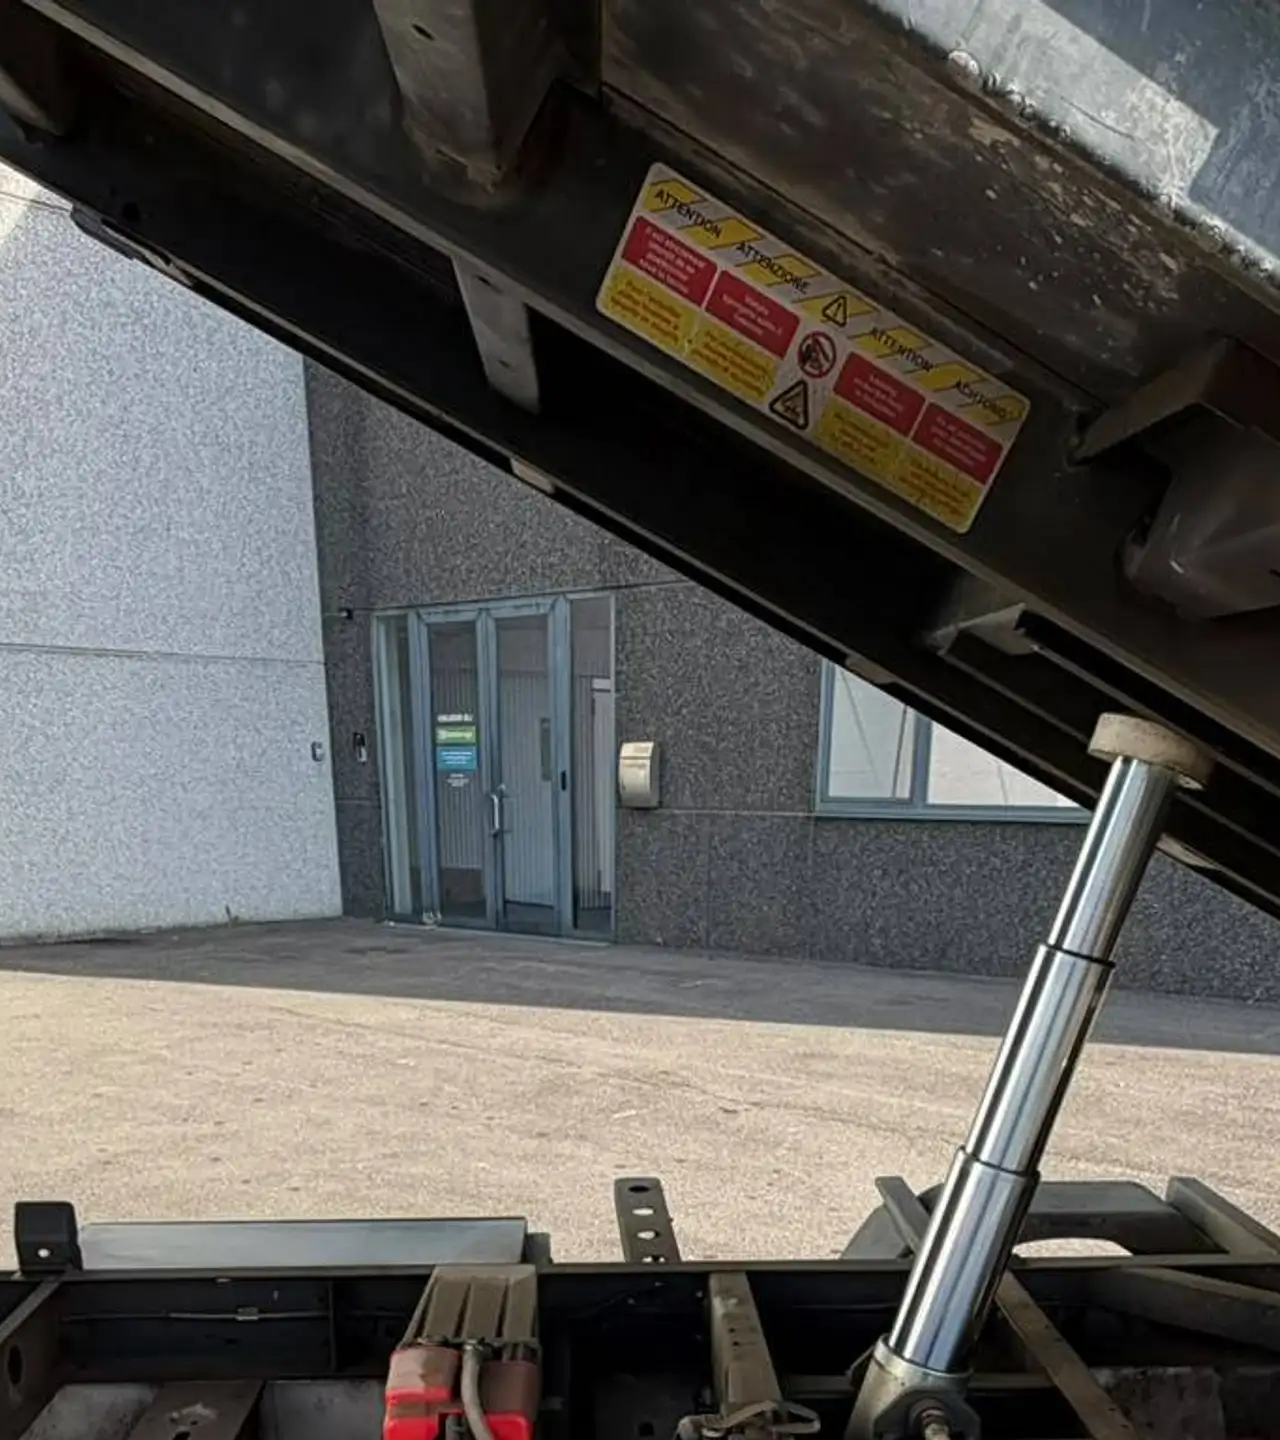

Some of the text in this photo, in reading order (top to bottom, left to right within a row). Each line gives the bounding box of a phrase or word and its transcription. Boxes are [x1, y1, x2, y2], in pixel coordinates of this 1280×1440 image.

[655, 188, 723, 239] ATTENTION
[736, 240, 812, 295] ATTENZIONE
[870, 326, 935, 373] ATTENTION
[955, 378, 1008, 420] ACHTUNG
